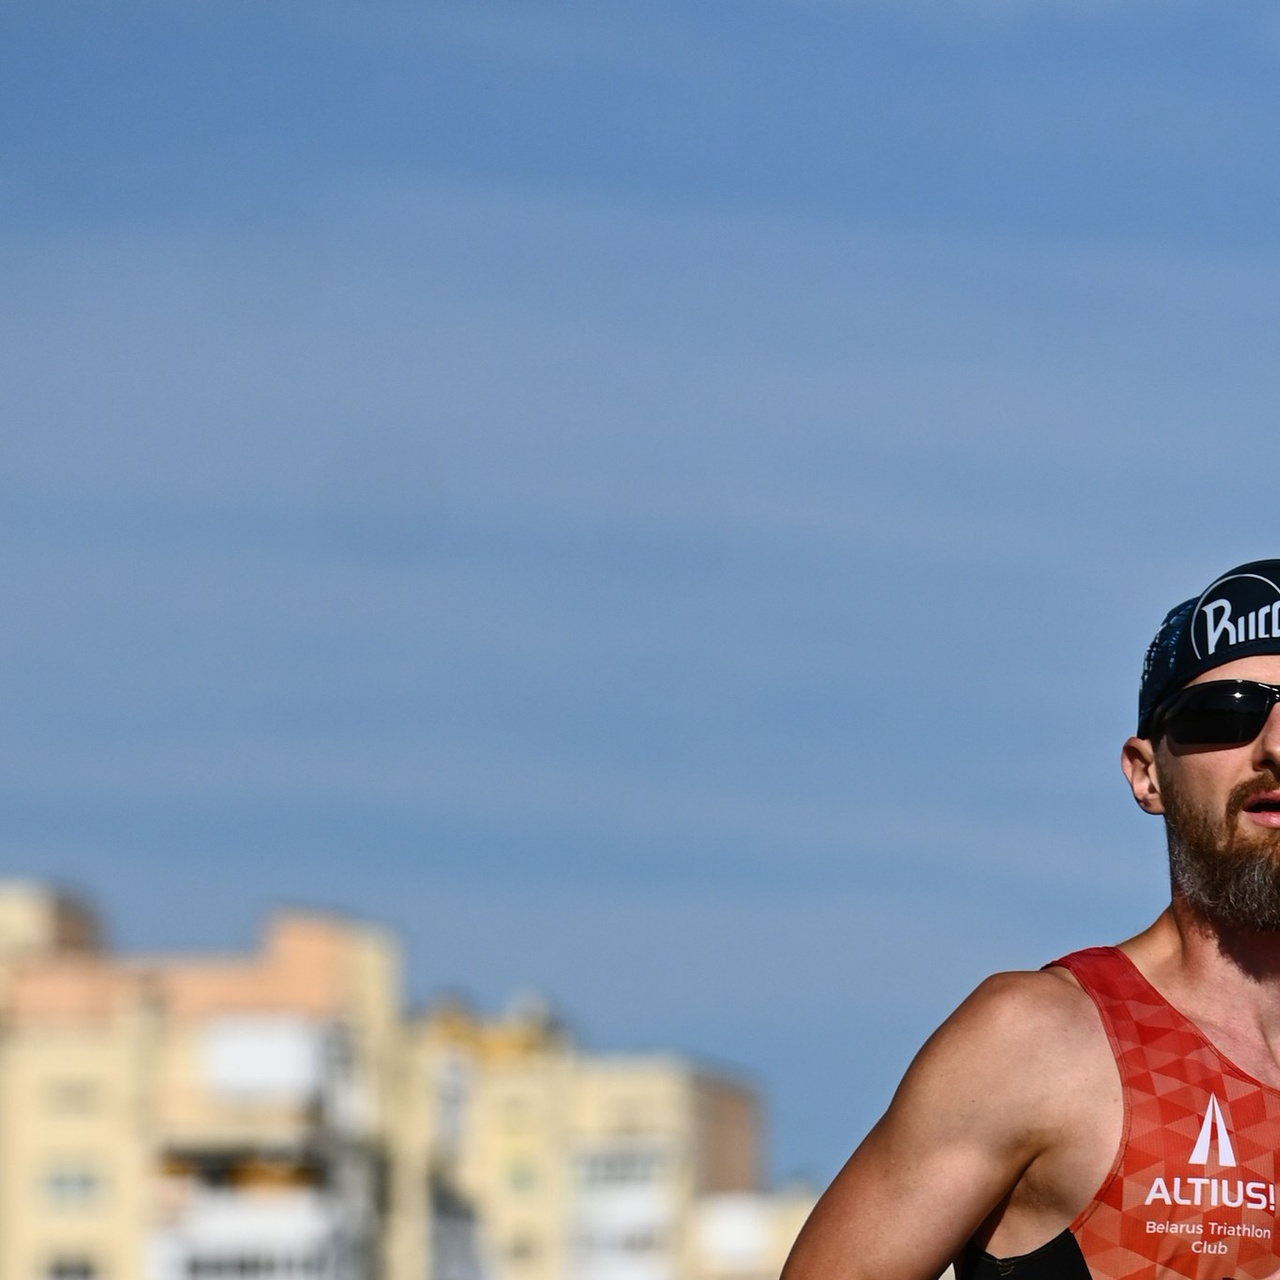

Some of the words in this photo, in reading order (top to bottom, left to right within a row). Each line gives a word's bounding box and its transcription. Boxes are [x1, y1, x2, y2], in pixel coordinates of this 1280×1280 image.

[1144, 1177, 1276, 1211] ALTIUS!
[1146, 1221, 1204, 1235] Belarus
[1207, 1222, 1272, 1239] Triathlon
[1191, 1240, 1229, 1255] Club
